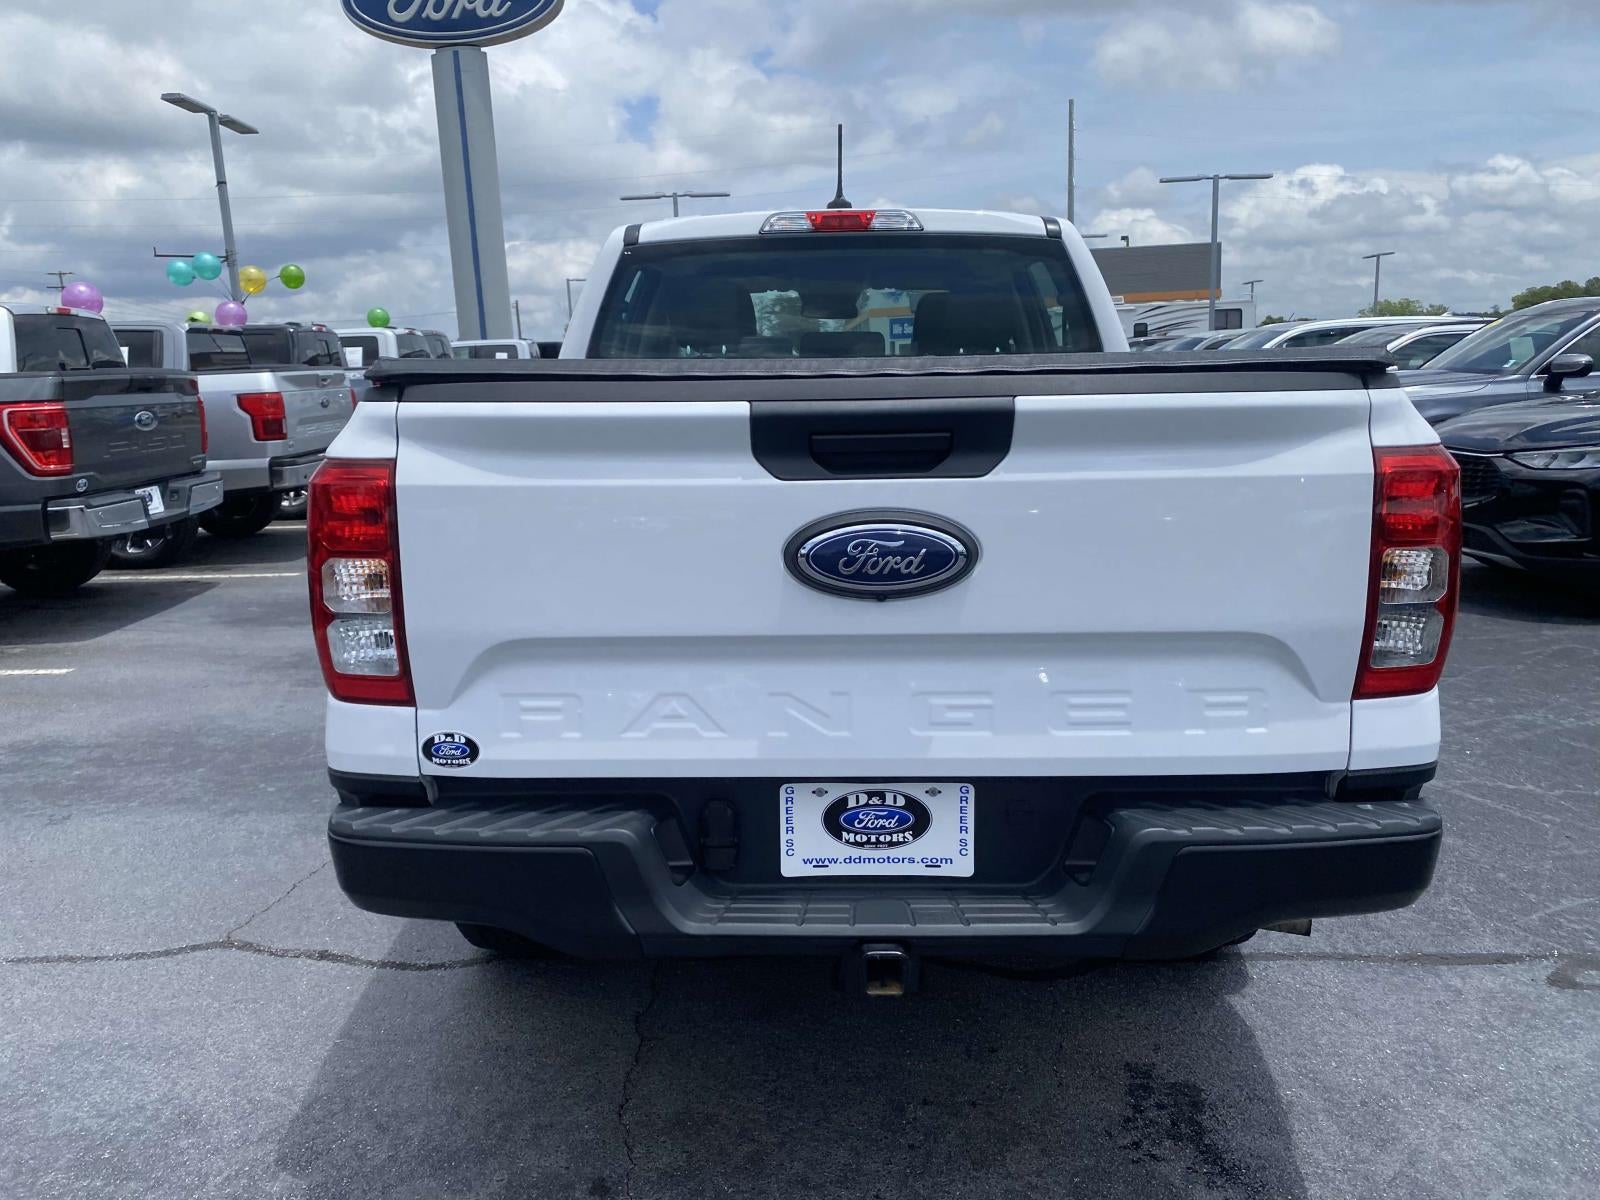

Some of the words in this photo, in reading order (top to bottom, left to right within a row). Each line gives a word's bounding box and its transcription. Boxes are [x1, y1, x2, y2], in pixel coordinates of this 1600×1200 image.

[838, 538, 927, 575] Ford
[499, 689, 1268, 738] RANGER
[434, 734, 466, 744] D&D
[438, 745, 462, 755] Ford
[432, 757, 471, 765] MOTORS
[846, 792, 906, 808] D&D
[785, 786, 795, 835] GREER
[854, 810, 900, 828] Ford
[959, 786, 970, 834] GREER
[841, 831, 914, 843] MOTORS
[785, 839, 795, 857] SC
[959, 838, 969, 857] SC
[802, 855, 953, 865] www.ddmotors.com
